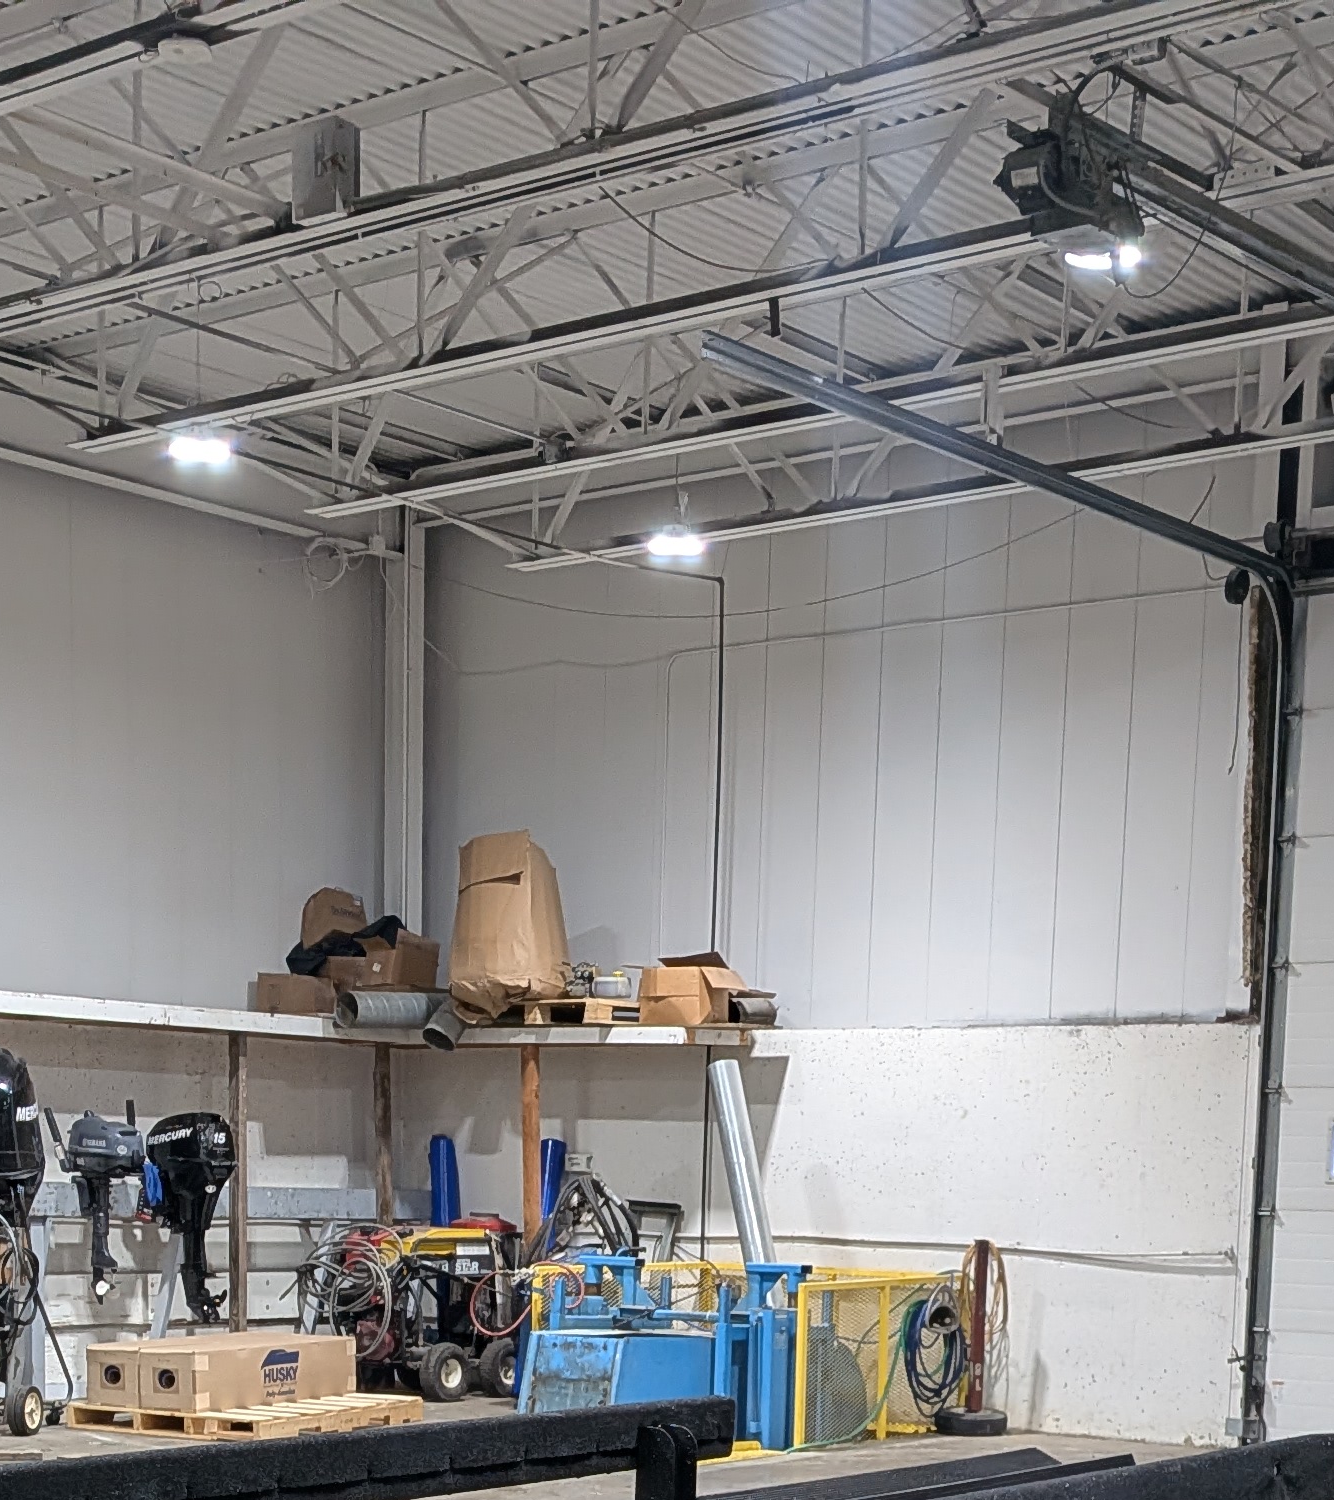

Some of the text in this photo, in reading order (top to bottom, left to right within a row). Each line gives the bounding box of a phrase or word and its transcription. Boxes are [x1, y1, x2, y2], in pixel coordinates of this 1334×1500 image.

[147, 1126, 194, 1146] MERCURY
[213, 1132, 227, 1145] 15
[263, 1365, 299, 1385] HUSKY
